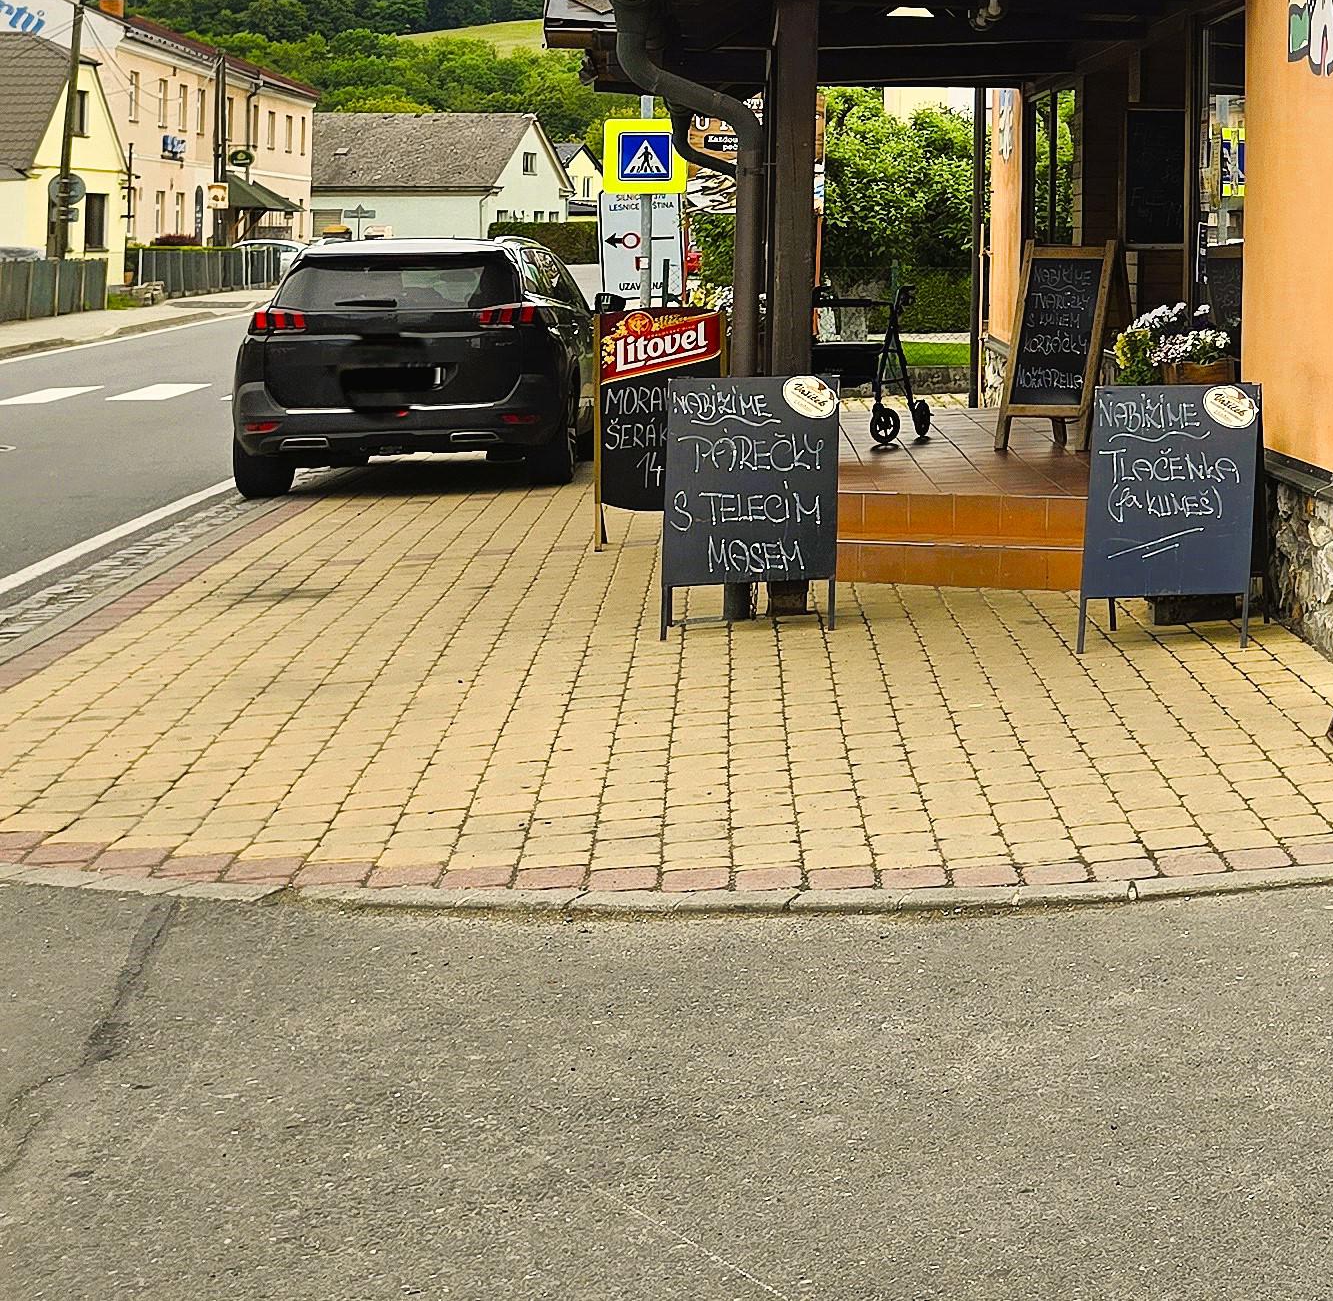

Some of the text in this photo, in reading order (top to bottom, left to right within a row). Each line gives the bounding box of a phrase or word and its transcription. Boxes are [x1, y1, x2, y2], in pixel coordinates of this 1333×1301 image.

[615, 321, 709, 372] Litovel
[605, 419, 668, 451] ŠERÁK
[670, 481, 822, 532] S TELECÍM
[707, 535, 806, 573] MASEM
